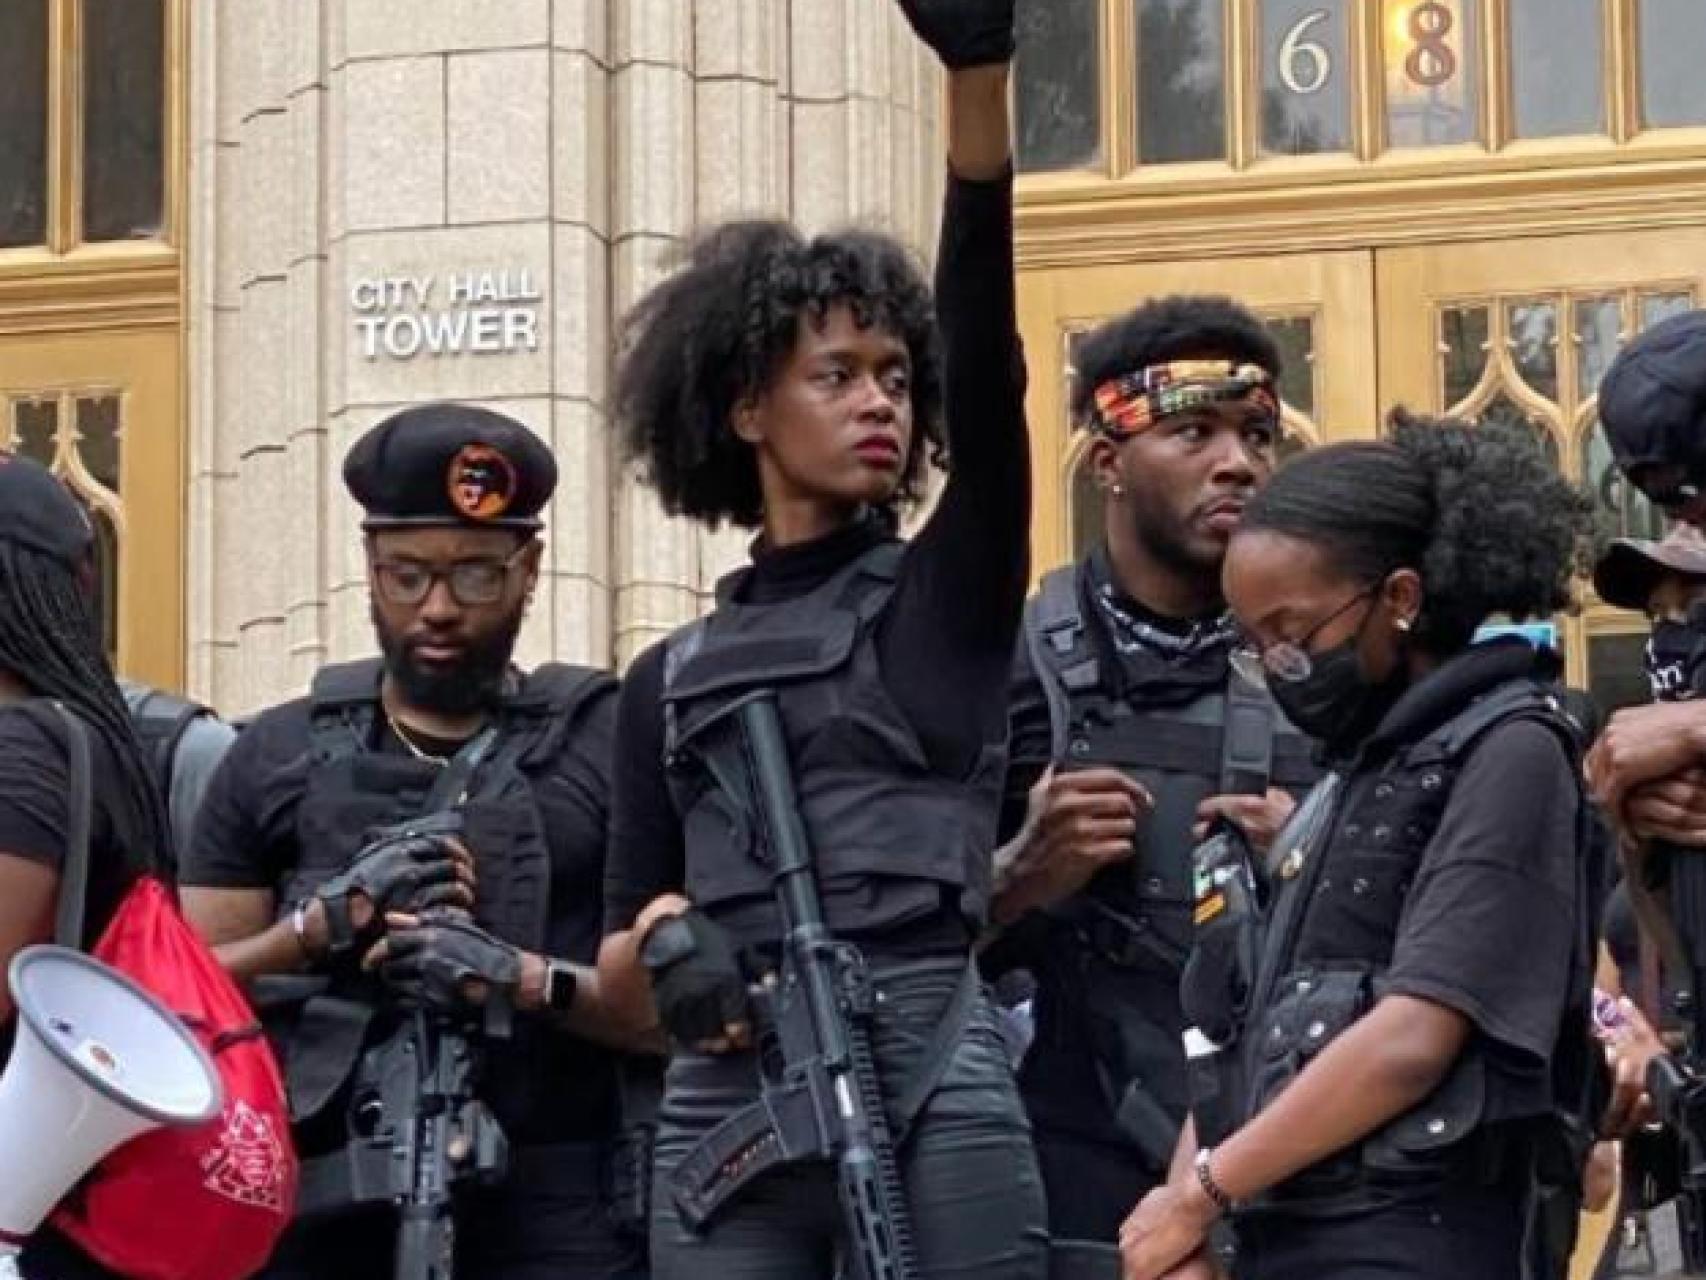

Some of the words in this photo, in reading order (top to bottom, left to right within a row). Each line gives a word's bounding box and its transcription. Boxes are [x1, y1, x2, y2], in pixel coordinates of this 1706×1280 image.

[352, 277, 433, 310] CITY
[449, 268, 541, 302] HALL
[352, 308, 537, 357] TOWER
